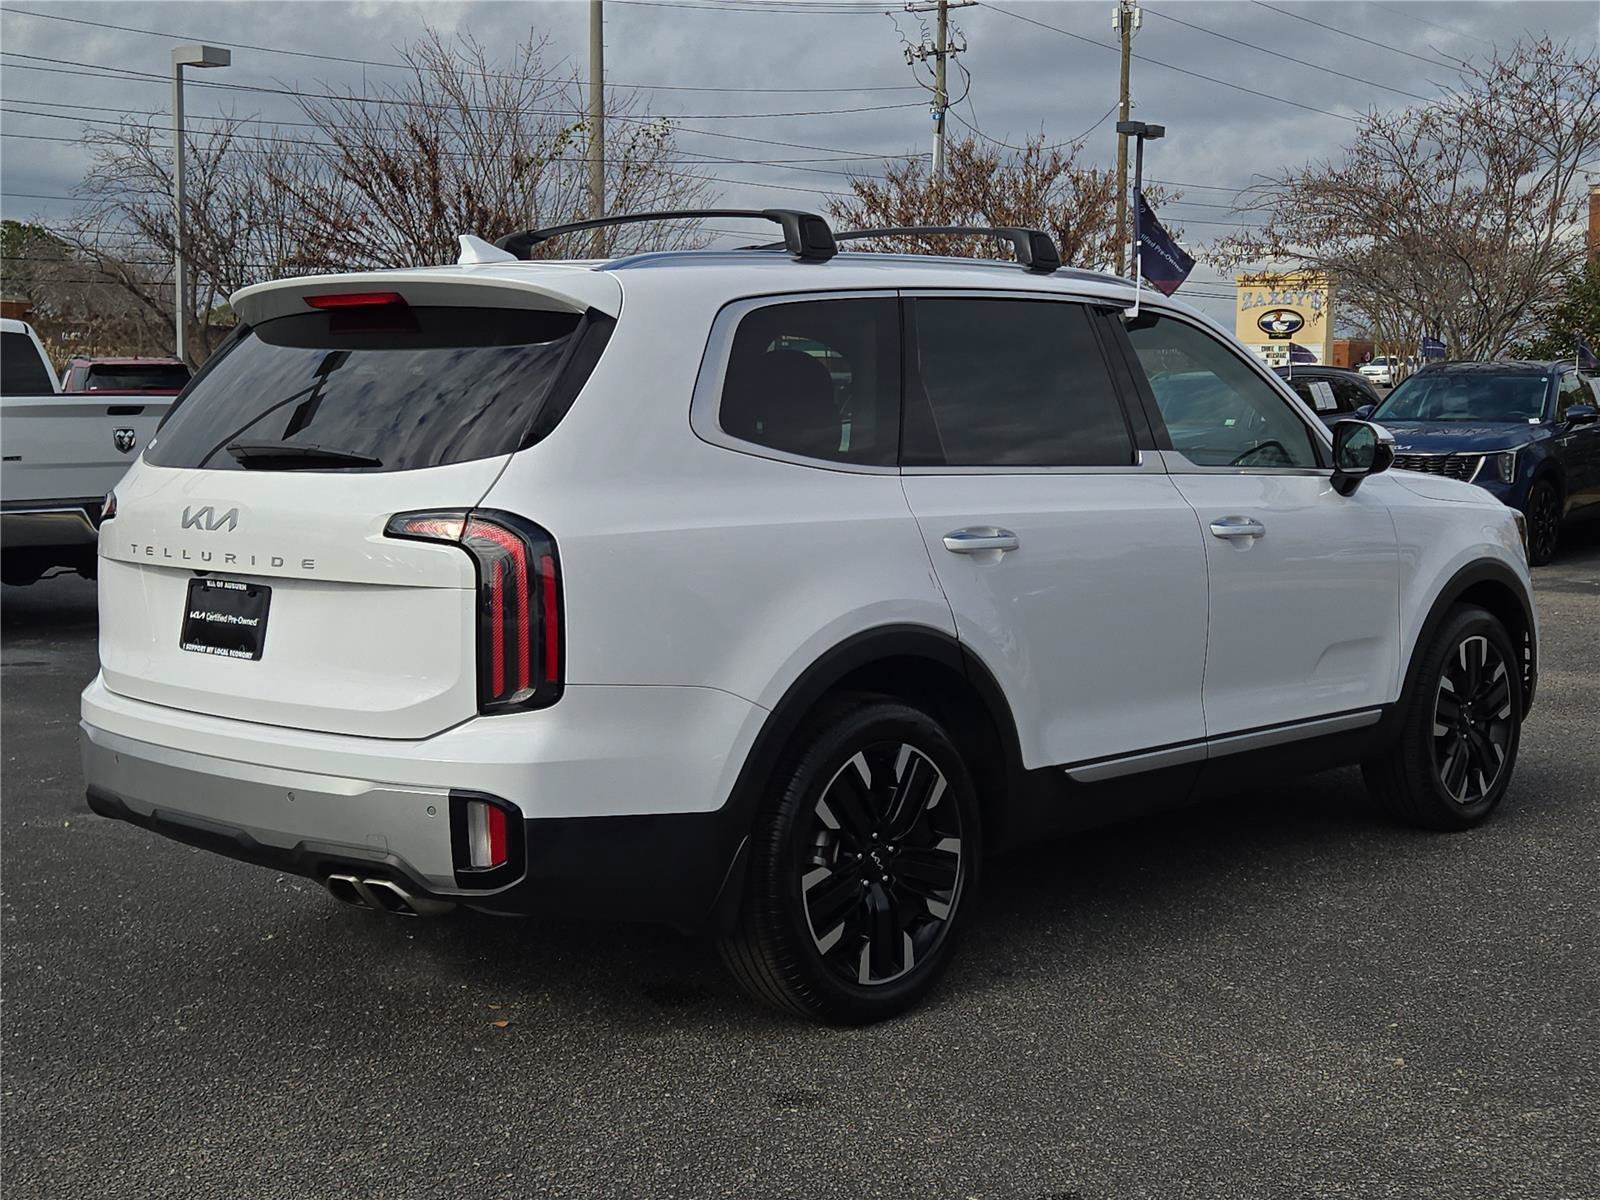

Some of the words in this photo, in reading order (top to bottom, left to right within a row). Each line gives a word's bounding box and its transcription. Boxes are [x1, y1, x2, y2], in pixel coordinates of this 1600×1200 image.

[1154, 244, 1183, 273] Pre-Owned
[182, 506, 239, 532] KIA
[131, 544, 315, 569] TELLURIDE
[216, 580, 224, 588] OF
[224, 582, 247, 590] AUBURN
[189, 610, 206, 619] KIA
[206, 611, 228, 622] Certified
[228, 614, 258, 626] Pre-Owned
[186, 643, 207, 652] SUPPORT
[214, 647, 230, 656] LOCAL
[229, 649, 253, 659] ECONOMY
